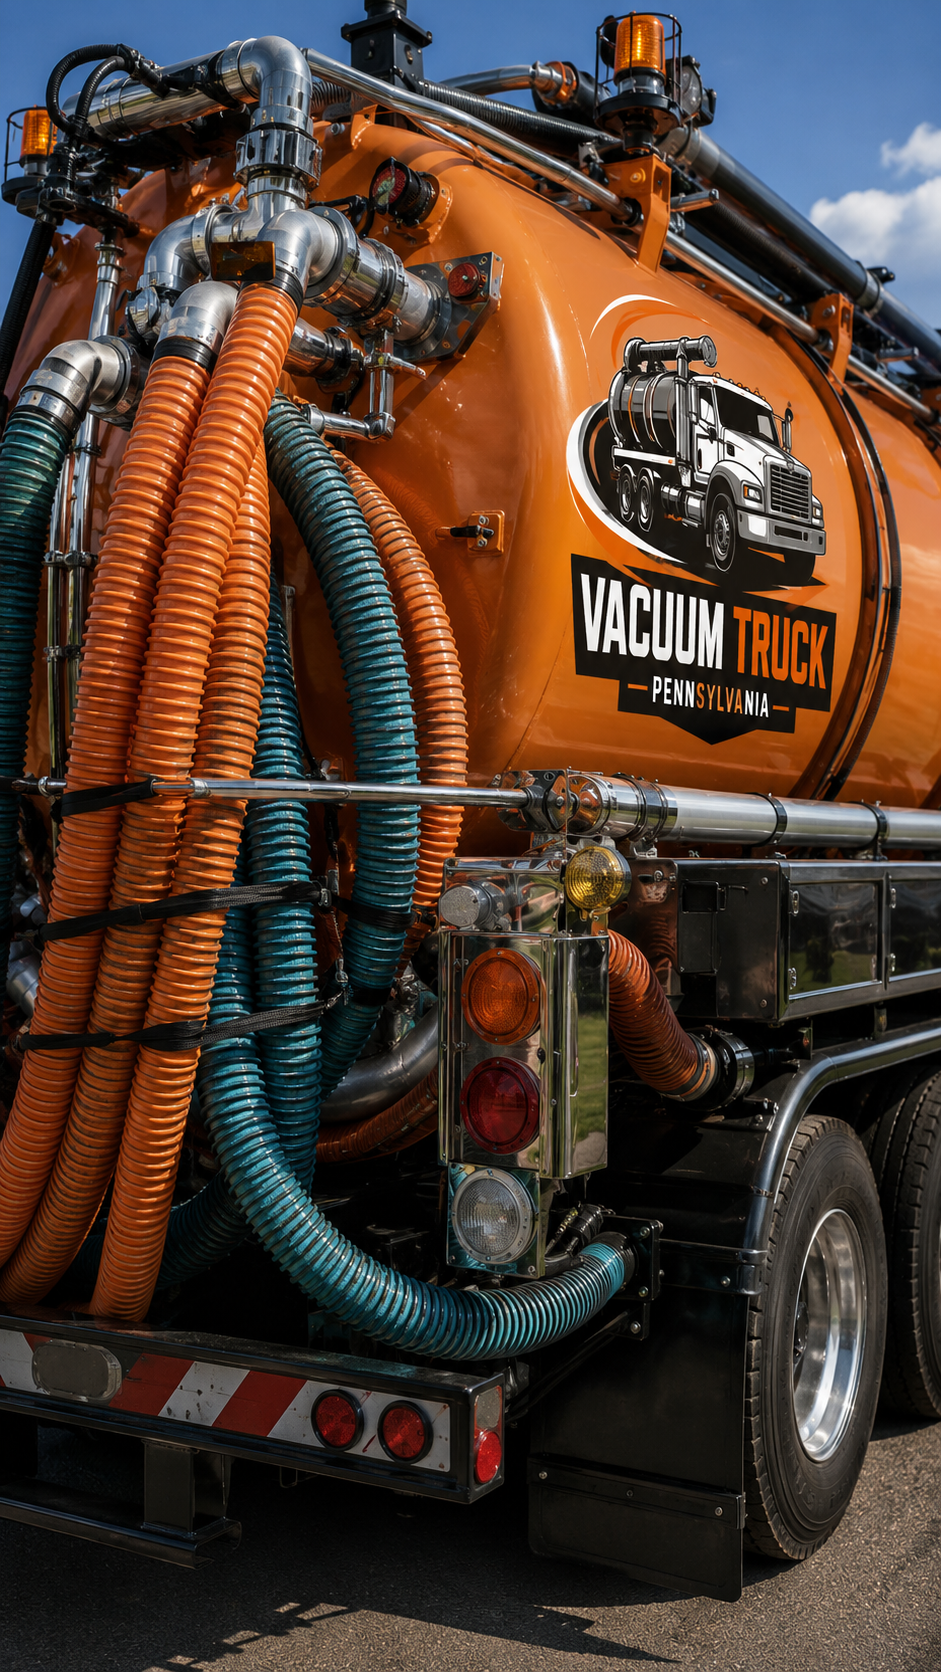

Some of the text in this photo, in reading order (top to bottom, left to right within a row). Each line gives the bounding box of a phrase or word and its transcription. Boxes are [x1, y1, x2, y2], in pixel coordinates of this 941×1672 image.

[580, 573, 829, 690] VACUUM TRUCK
[652, 675, 769, 718] PENNSYLVANIA
